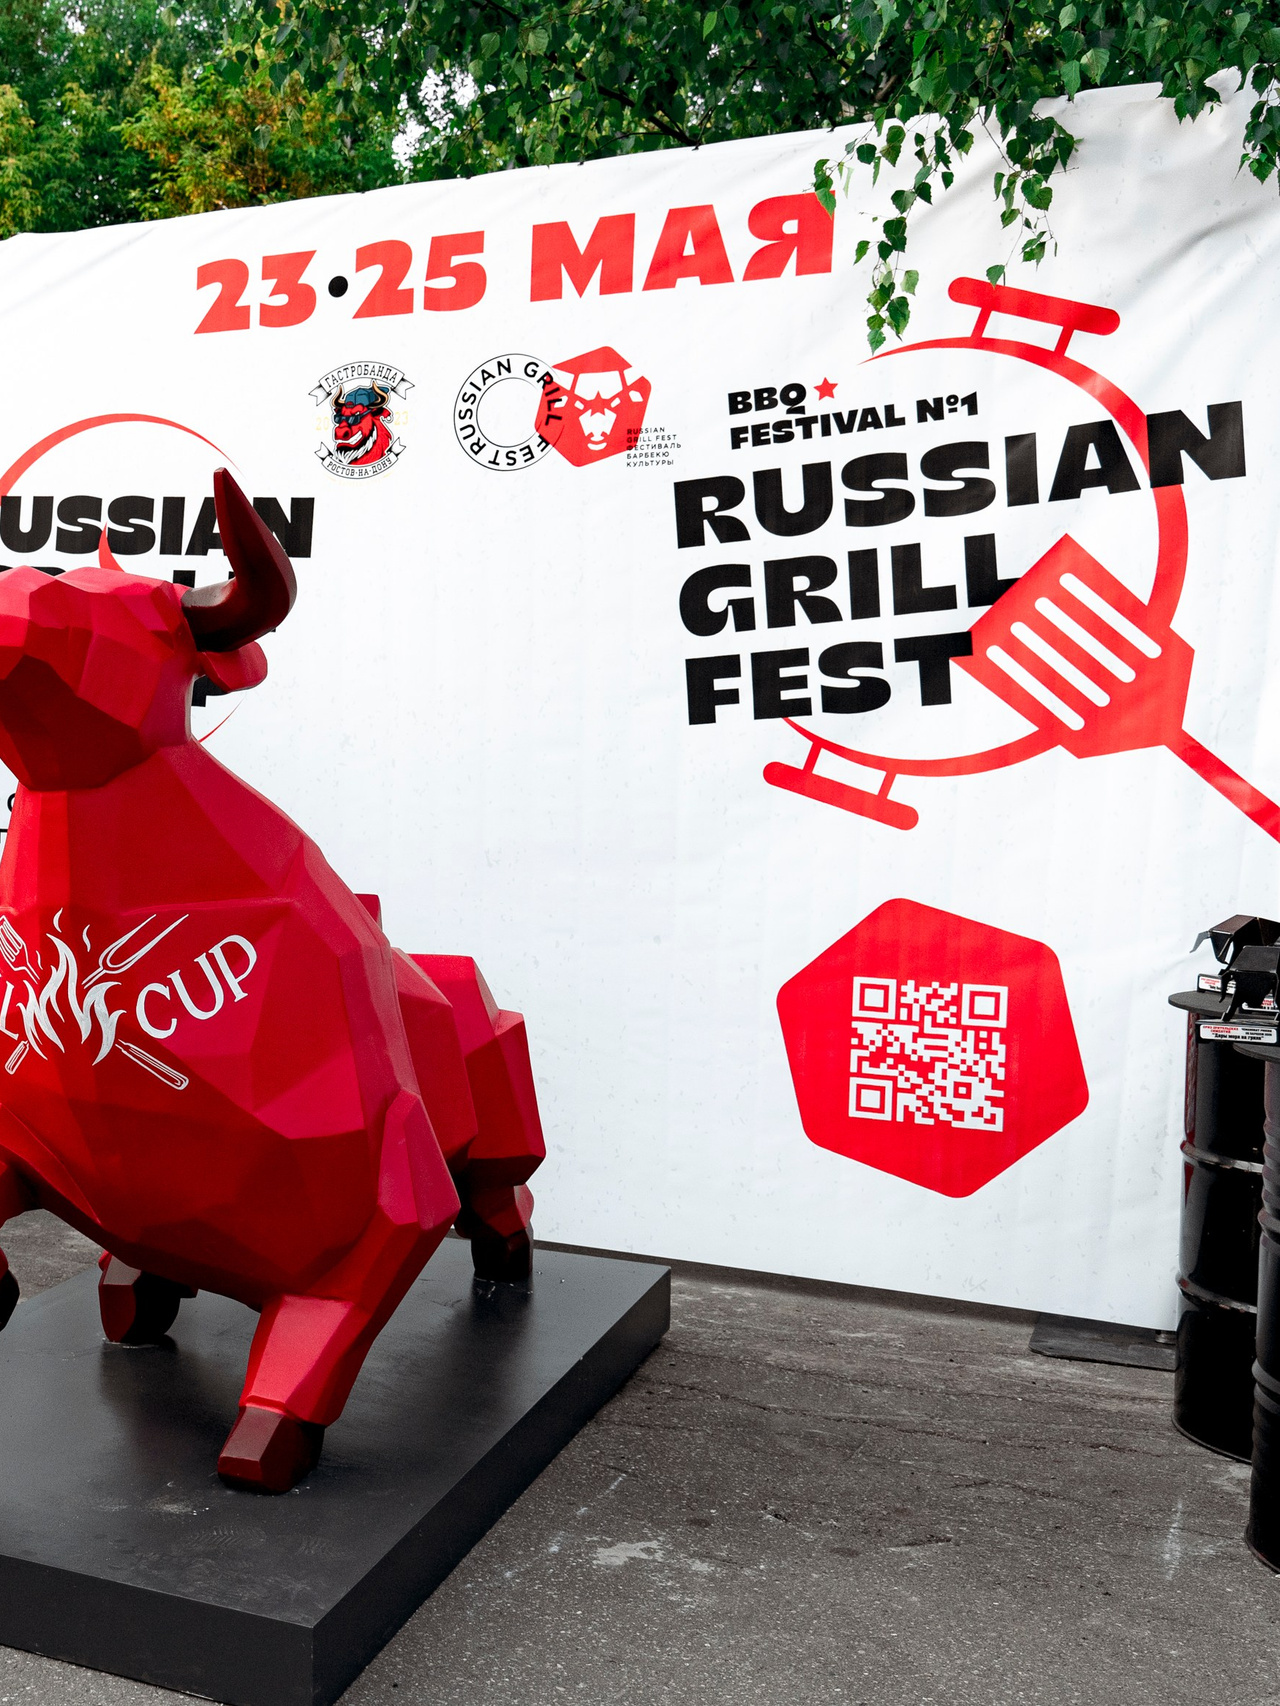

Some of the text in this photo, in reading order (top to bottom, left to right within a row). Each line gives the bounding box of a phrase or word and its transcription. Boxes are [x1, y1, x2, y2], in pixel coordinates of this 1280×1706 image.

[530, 191, 837, 302] МАЯ
[324, 364, 399, 388] ГАСТРОБАНДА
[727, 382, 808, 415] BBQ
[458, 358, 563, 466] RUSSIAN GRILL FEST
[626, 427, 665, 435] RUSSIAN
[626, 442, 682, 451] ФЕСТИВАЛЬ
[730, 403, 906, 450] FESTIVAL
[626, 451, 669, 459] БАРБЕКЮ
[673, 400, 1247, 549] RUSSIAN
[678, 532, 1022, 637] GRILL
[685, 631, 974, 725] FEST
[135, 934, 258, 1040] CUP
